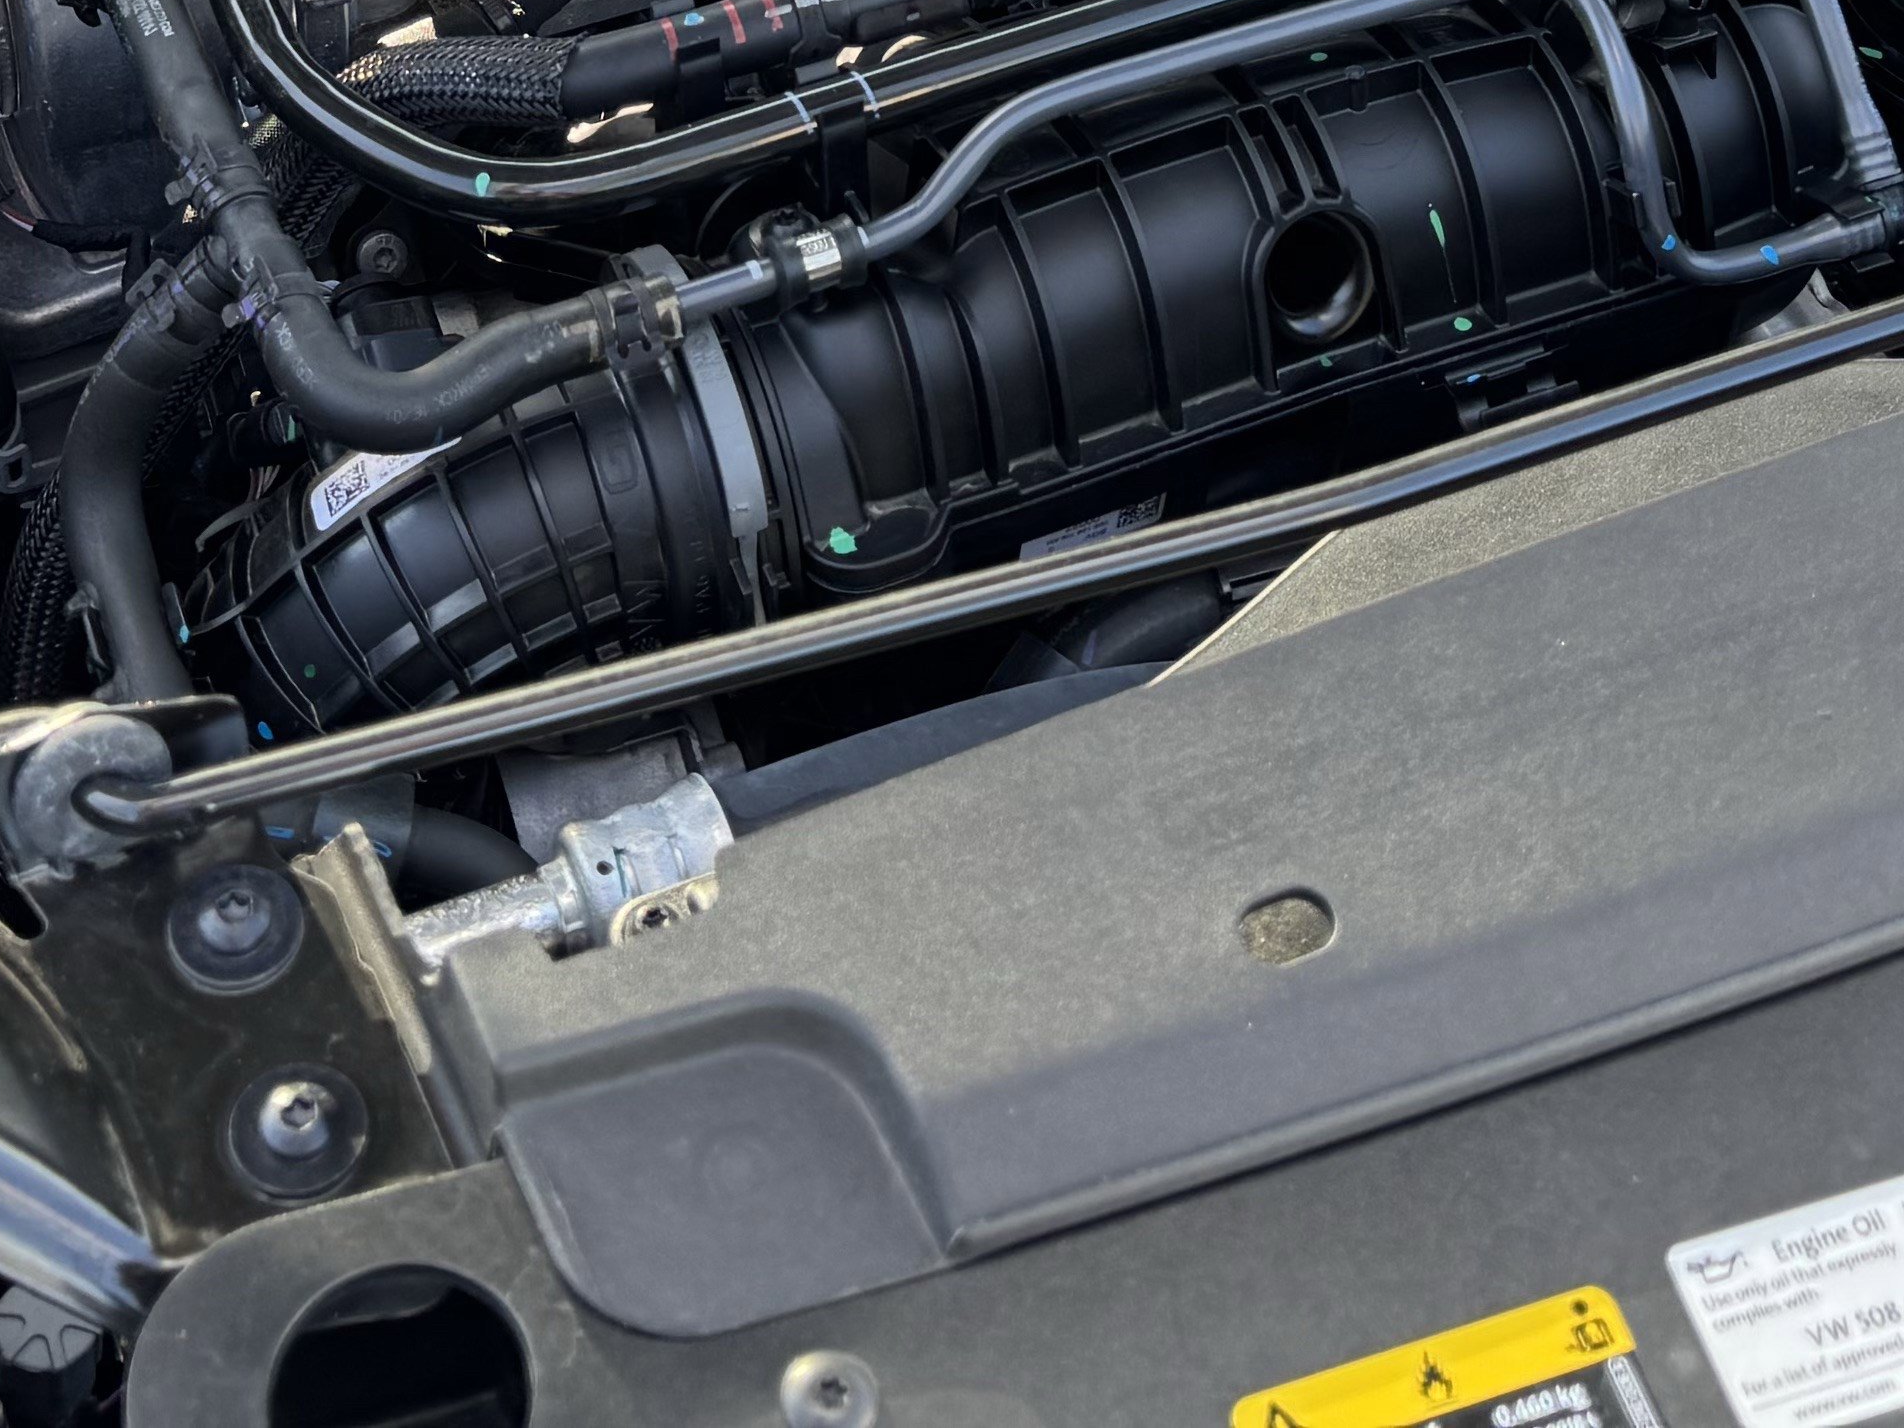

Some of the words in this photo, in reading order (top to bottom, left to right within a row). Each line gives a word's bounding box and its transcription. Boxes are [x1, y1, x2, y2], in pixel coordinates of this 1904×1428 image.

[1771, 1224, 1848, 1263] Engine
[1852, 1209, 1886, 1236] Oil
[1702, 1293, 1731, 1311] Use
[1734, 1283, 1768, 1307] only
[1771, 1273, 1791, 1292] oil
[1796, 1263, 1824, 1285] that
[1827, 1240, 1897, 1272] expressly
[1712, 1301, 1782, 1333] complies
[1786, 1288, 1820, 1310] with
[1805, 1316, 1850, 1345] VW
[1855, 1301, 1901, 1333] 508
[1741, 1380, 1766, 1397] For
[1784, 1364, 1808, 1382] list
[1812, 1355, 1828, 1375] of
[1832, 1332, 1904, 1370] approved
